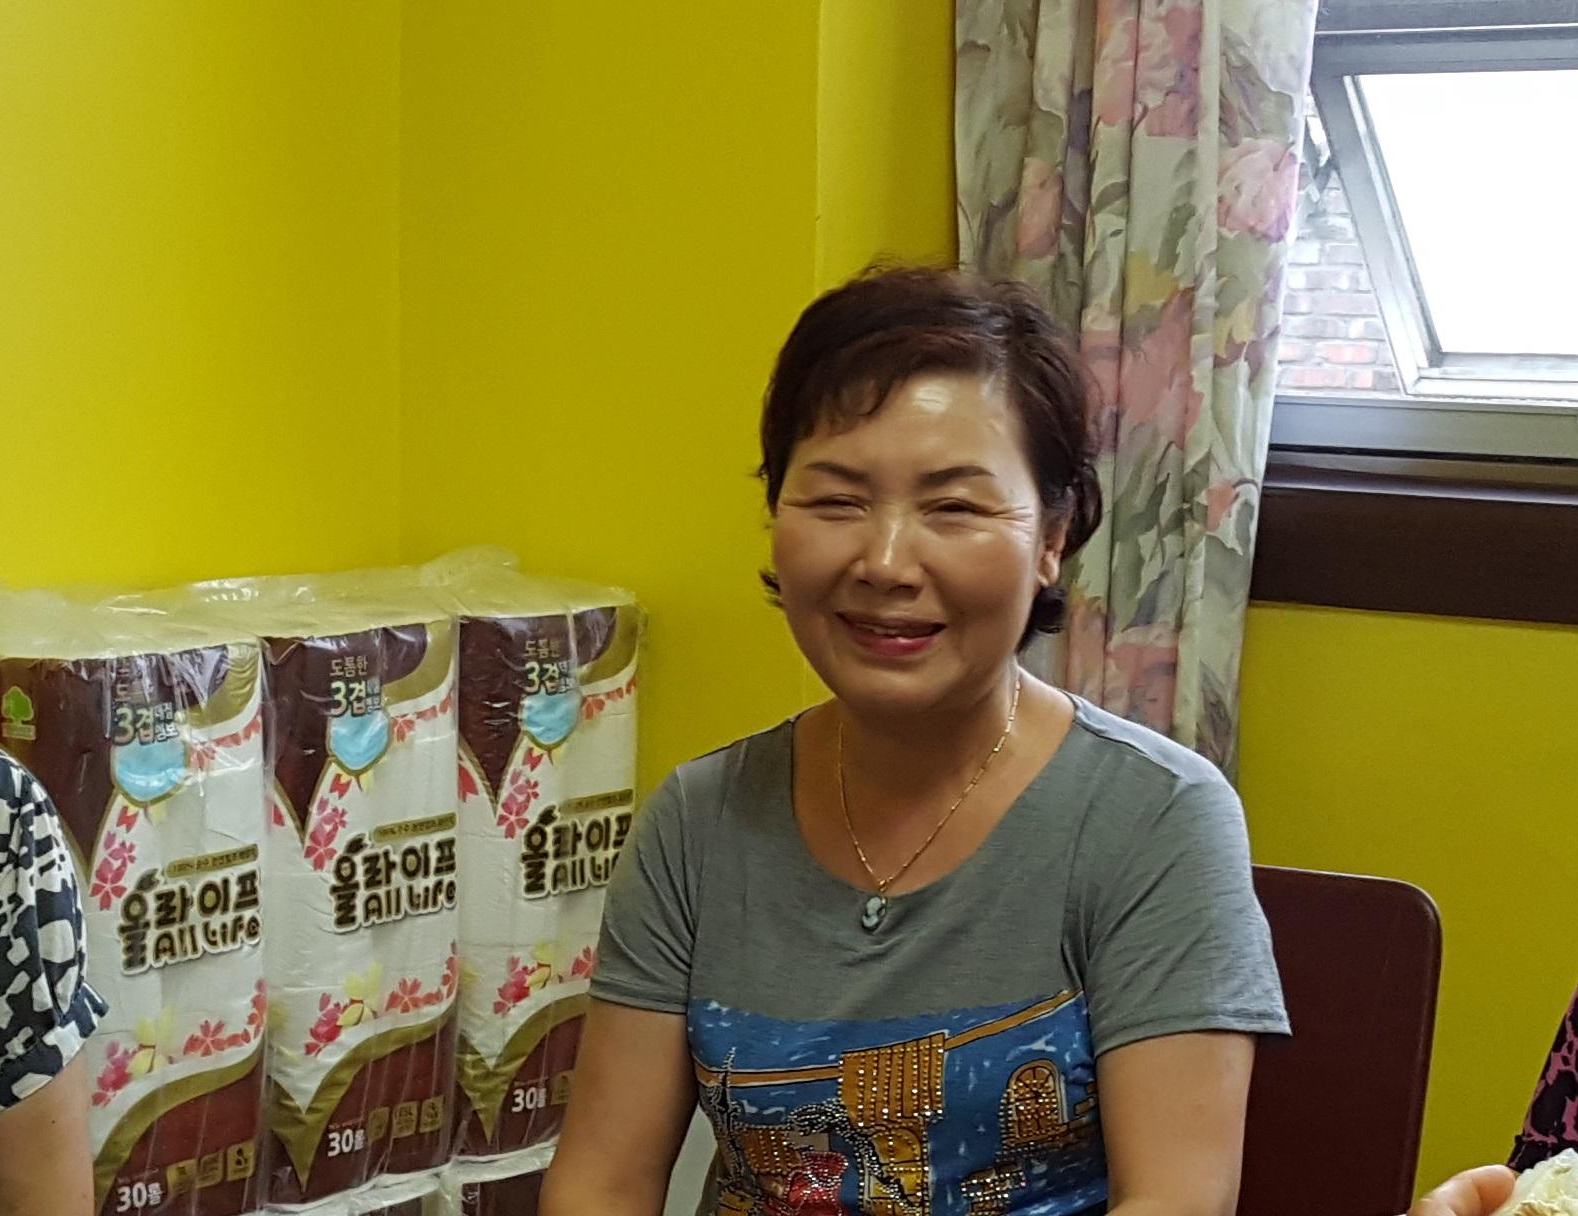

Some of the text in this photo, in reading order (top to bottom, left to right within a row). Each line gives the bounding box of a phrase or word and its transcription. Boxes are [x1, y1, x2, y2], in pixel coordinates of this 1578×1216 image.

[329, 655, 369, 678] 도톰한
[524, 661, 560, 694] 3겹
[330, 680, 366, 715] 3겹
[114, 706, 154, 744] 3겹
[521, 813, 632, 893] 올라이프
[552, 852, 620, 892] All Li
[330, 837, 456, 926] 올라이프
[364, 868, 457, 923] All Life
[118, 869, 259, 971] 올라이프
[154, 914, 260, 962] All Life
[116, 1182, 164, 1213] 30롤
